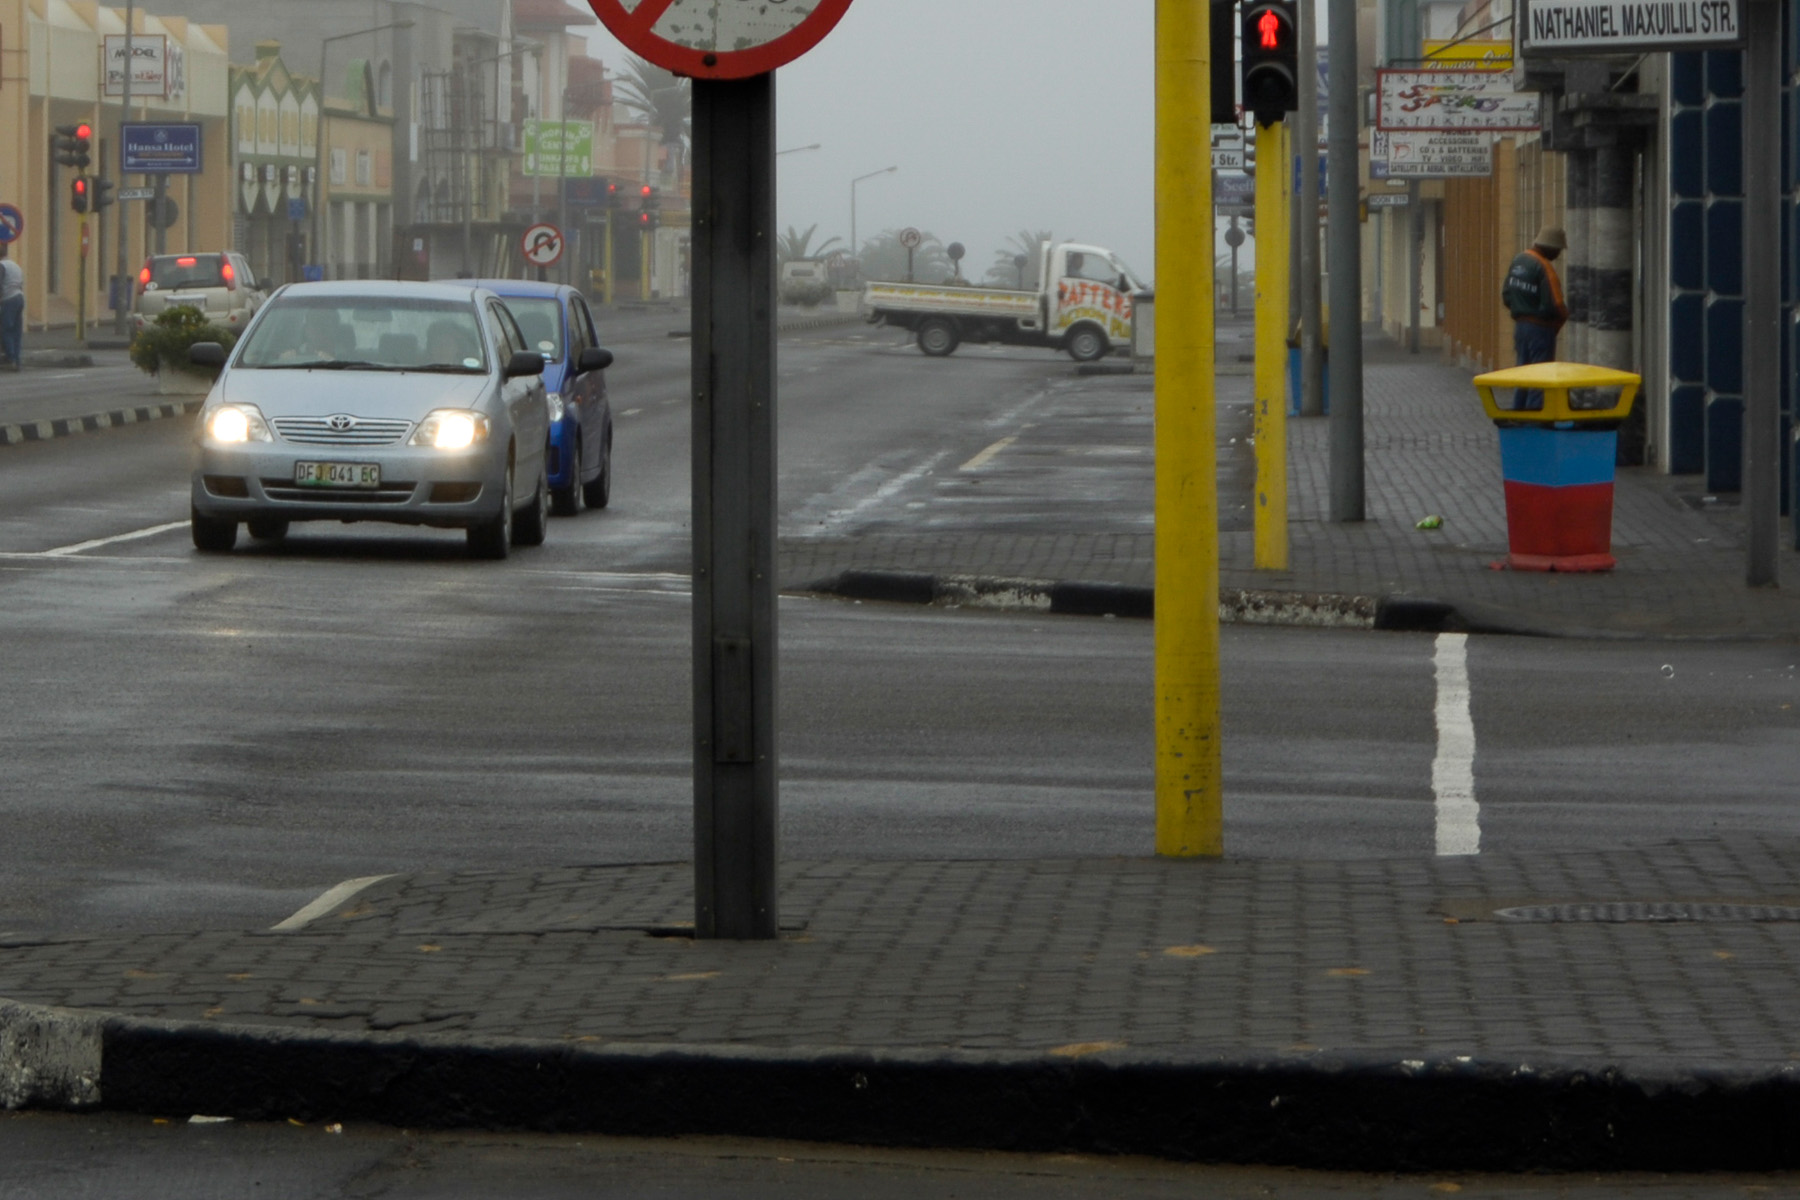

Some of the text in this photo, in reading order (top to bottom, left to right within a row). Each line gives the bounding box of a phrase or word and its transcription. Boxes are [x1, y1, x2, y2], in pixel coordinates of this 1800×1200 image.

[1533, 0, 1736, 40] NATHANIEL MAXUILILI STR.
[164, 142, 194, 151] Hotel
[1428, 137, 1480, 145] ACCESSORIES
[1447, 146, 1489, 154] BATTERIES
[1218, 153, 1239, 166] Str.
[329, 465, 354, 482] 041
[361, 466, 378, 483] EC
